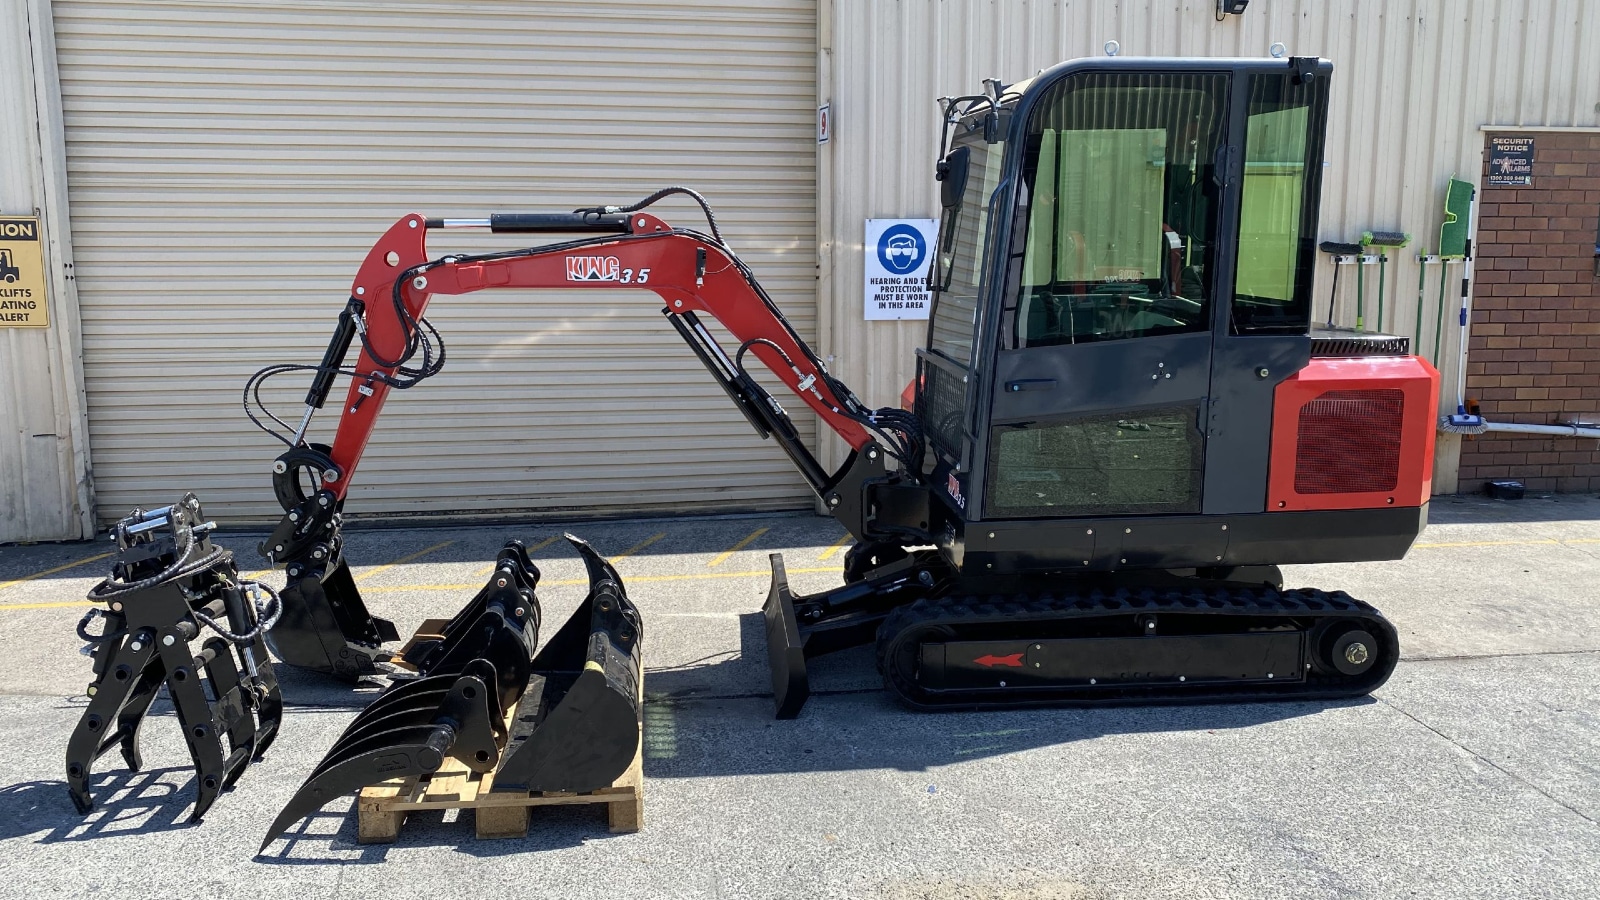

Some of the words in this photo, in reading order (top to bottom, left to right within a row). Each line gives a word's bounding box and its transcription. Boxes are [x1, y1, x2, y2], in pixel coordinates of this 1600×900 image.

[565, 256, 620, 282] KING
[620, 268, 651, 284] 3.5
[870, 277, 901, 285] HEARING
[903, 277, 919, 285] AND
[0, 301, 37, 310] ATING
